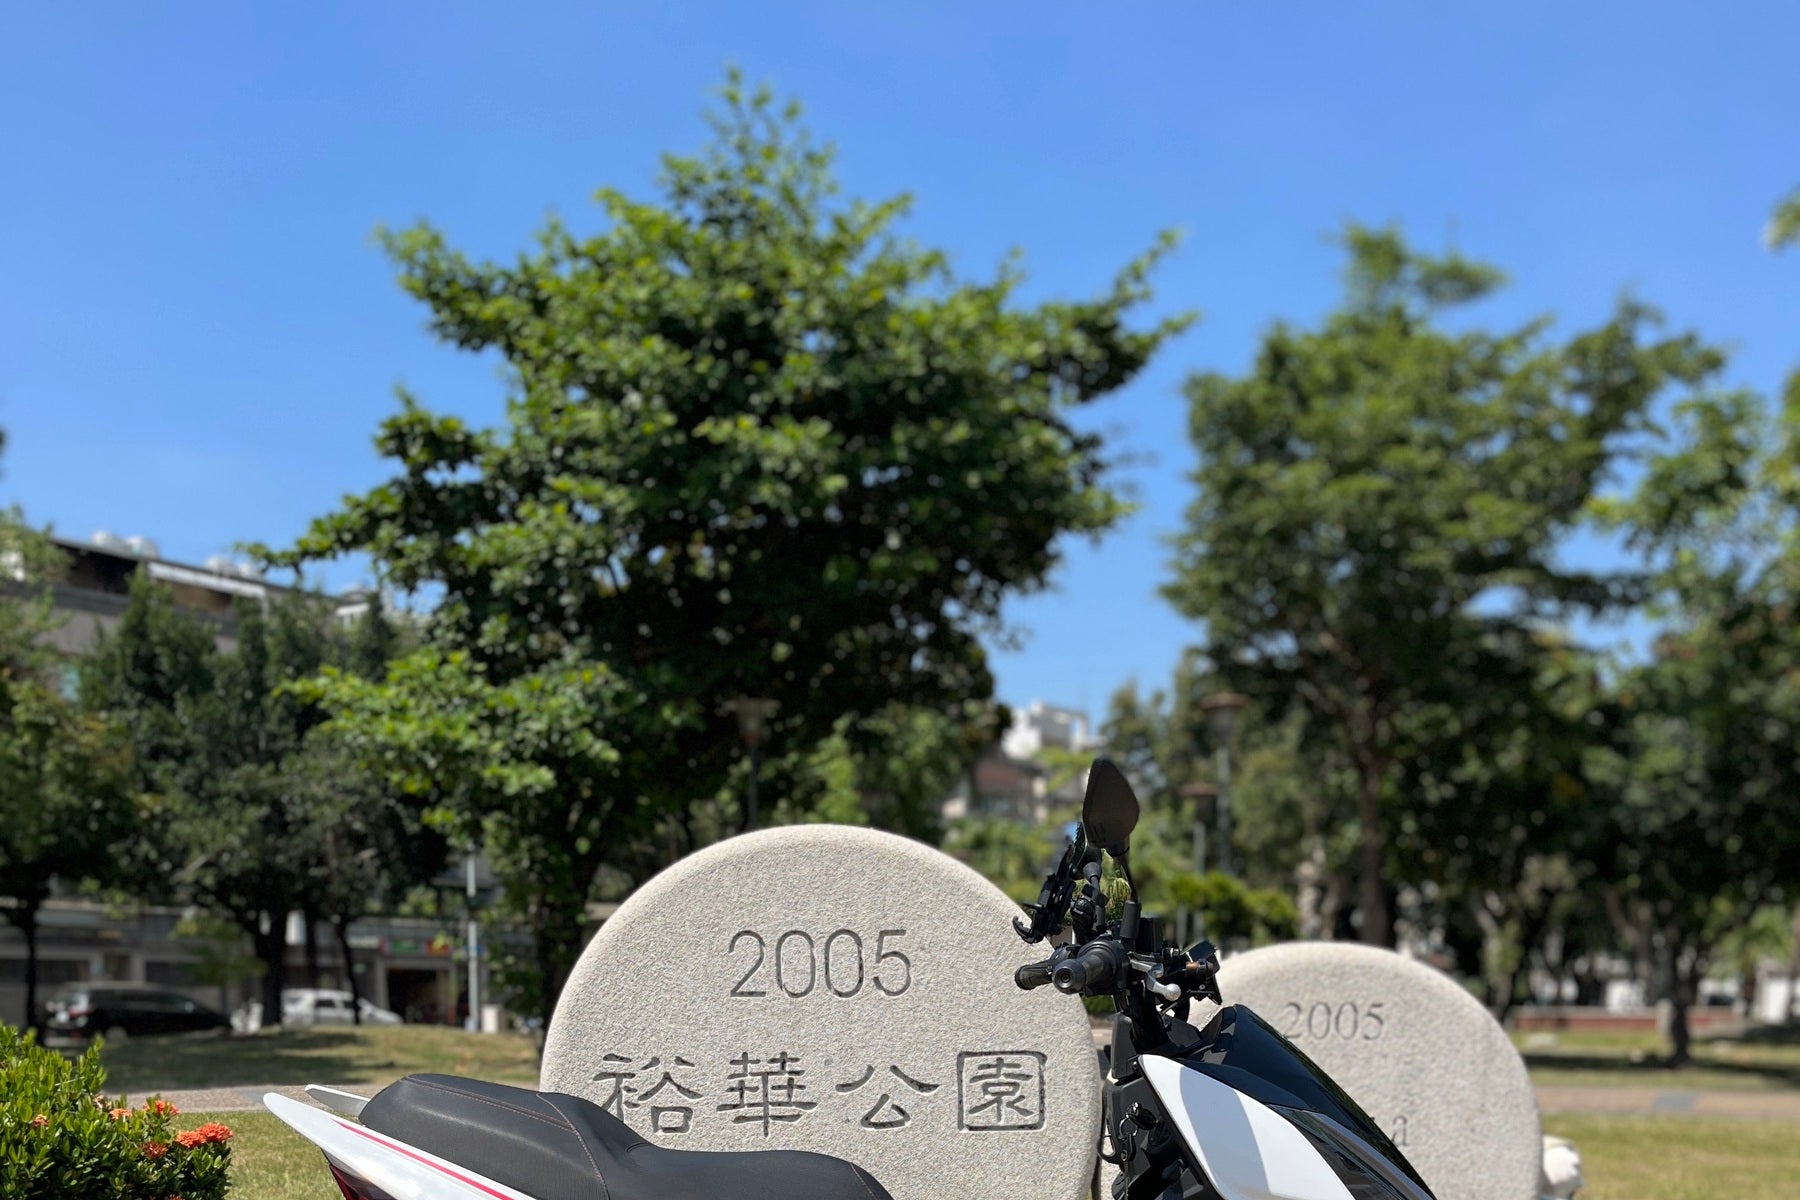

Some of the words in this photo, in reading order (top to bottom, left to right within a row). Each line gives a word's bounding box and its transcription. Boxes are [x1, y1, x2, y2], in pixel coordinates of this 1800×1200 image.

[728, 929, 911, 997] 2005
[1282, 1003, 1384, 1040] 2005
[592, 1051, 1048, 1137] 裕華公園
